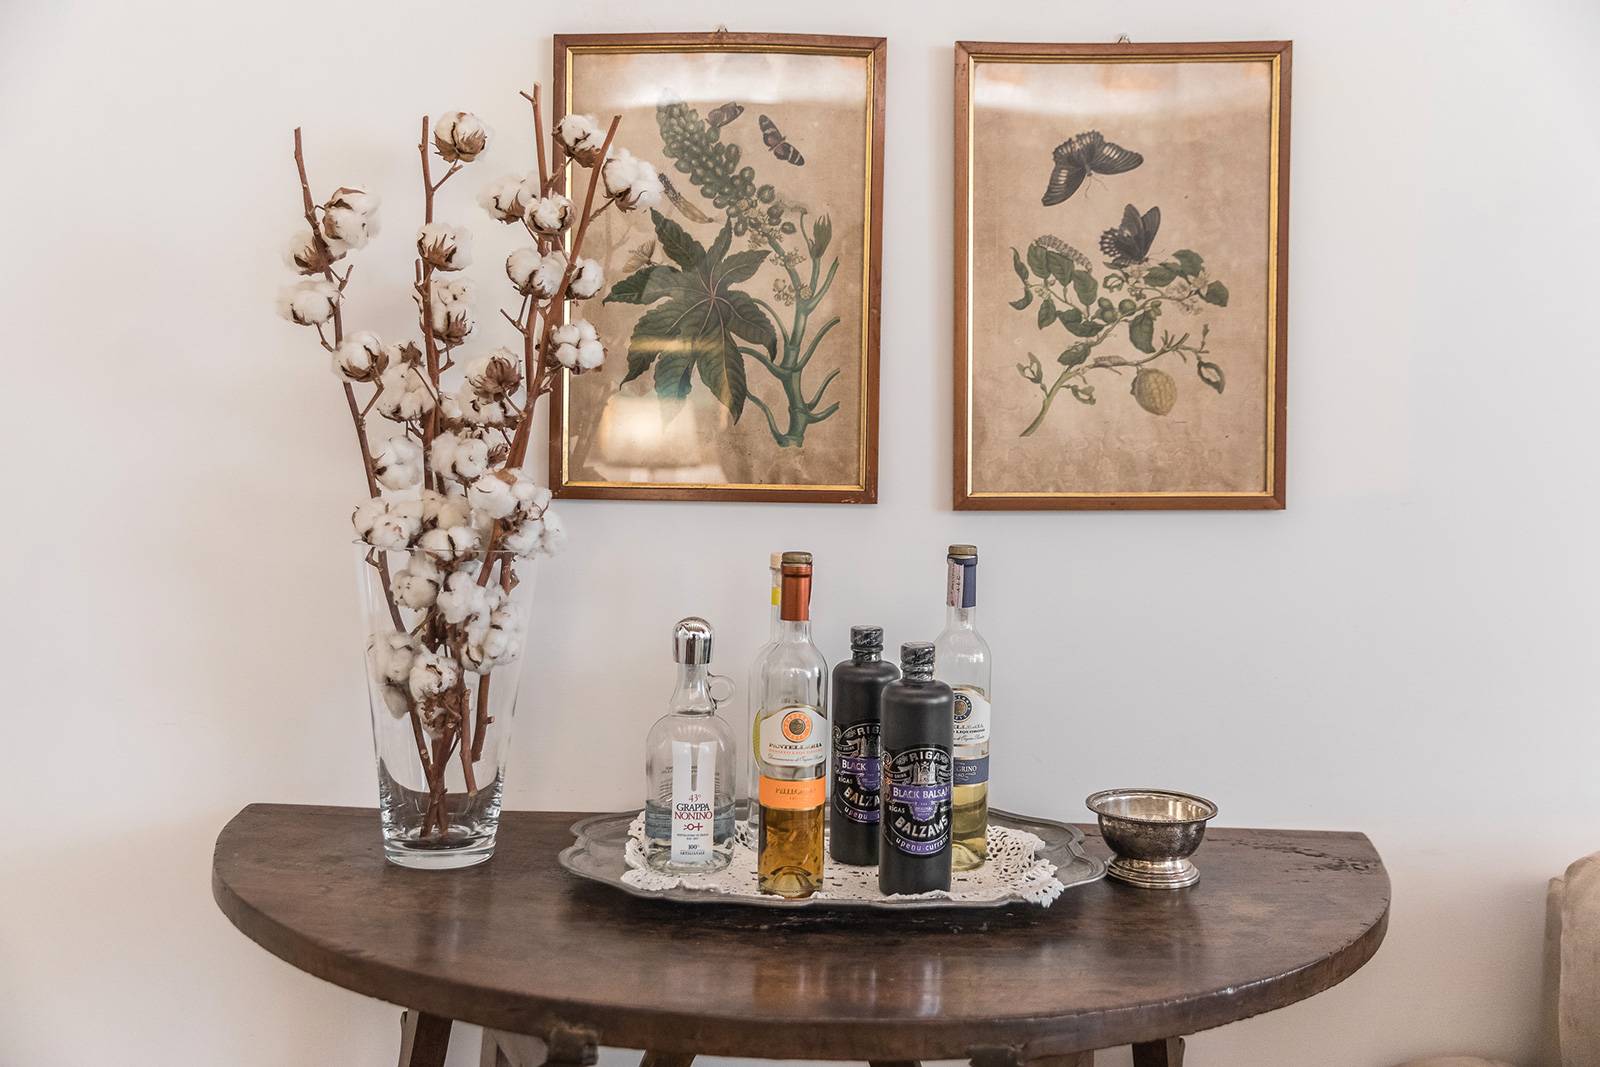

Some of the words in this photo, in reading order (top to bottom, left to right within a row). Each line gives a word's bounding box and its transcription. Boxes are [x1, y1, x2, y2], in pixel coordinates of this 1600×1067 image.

[857, 726, 880, 736] RIG
[909, 751, 940, 762] RIGA
[842, 759, 867, 771] BLACK
[893, 787, 920, 799] BLACK
[676, 802, 710, 811] GRAPPA
[674, 811, 713, 820] NONINO
[895, 815, 948, 838] BALZAMS
